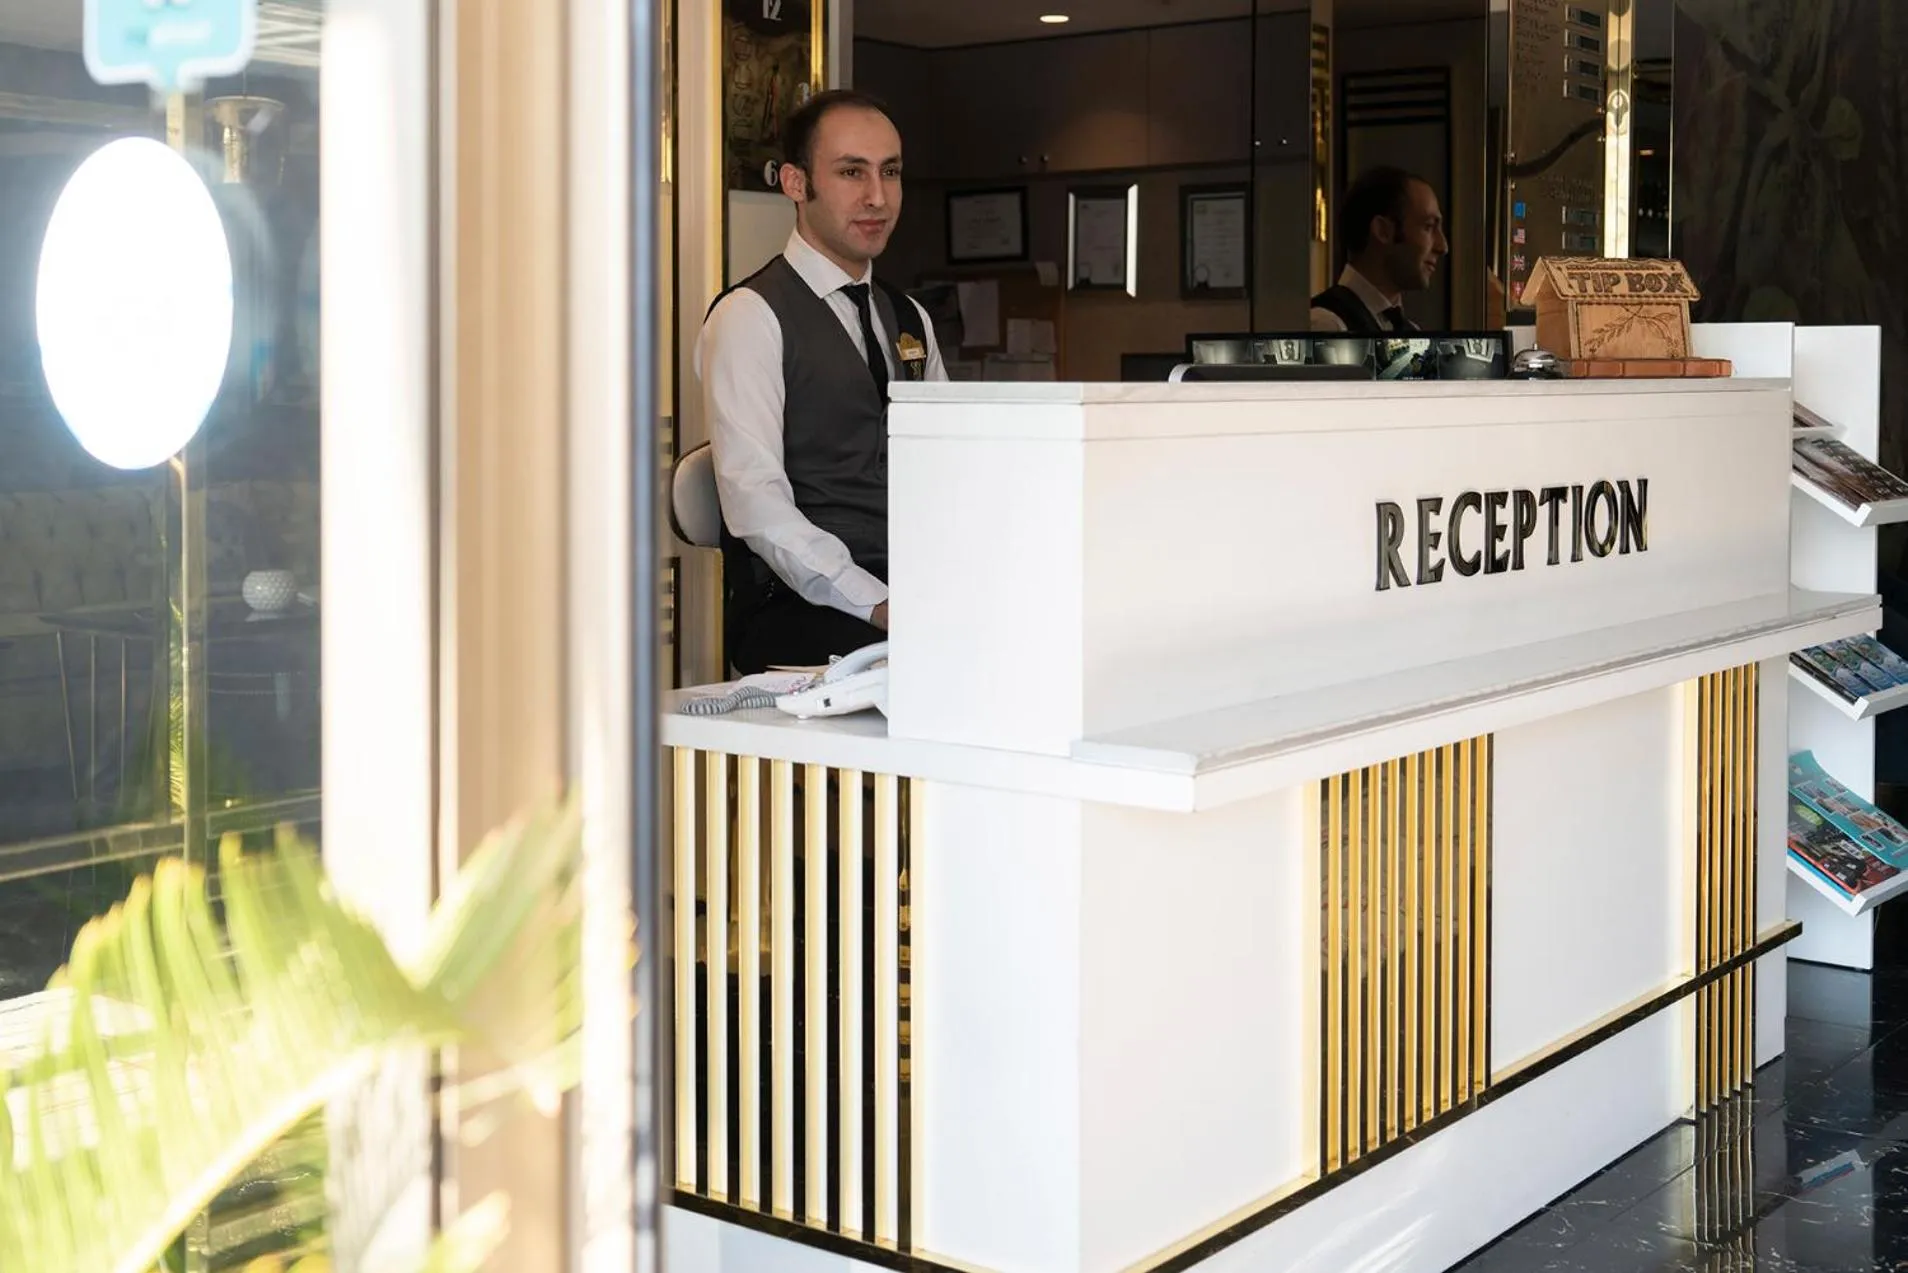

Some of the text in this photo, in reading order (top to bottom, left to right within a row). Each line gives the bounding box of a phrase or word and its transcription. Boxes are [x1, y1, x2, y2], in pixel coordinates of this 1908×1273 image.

[763, 0, 782, 21] 12
[764, 160, 778, 187] 6
[1568, 271, 1688, 294] TIP BOX
[1375, 478, 1649, 591] RECEPTION
